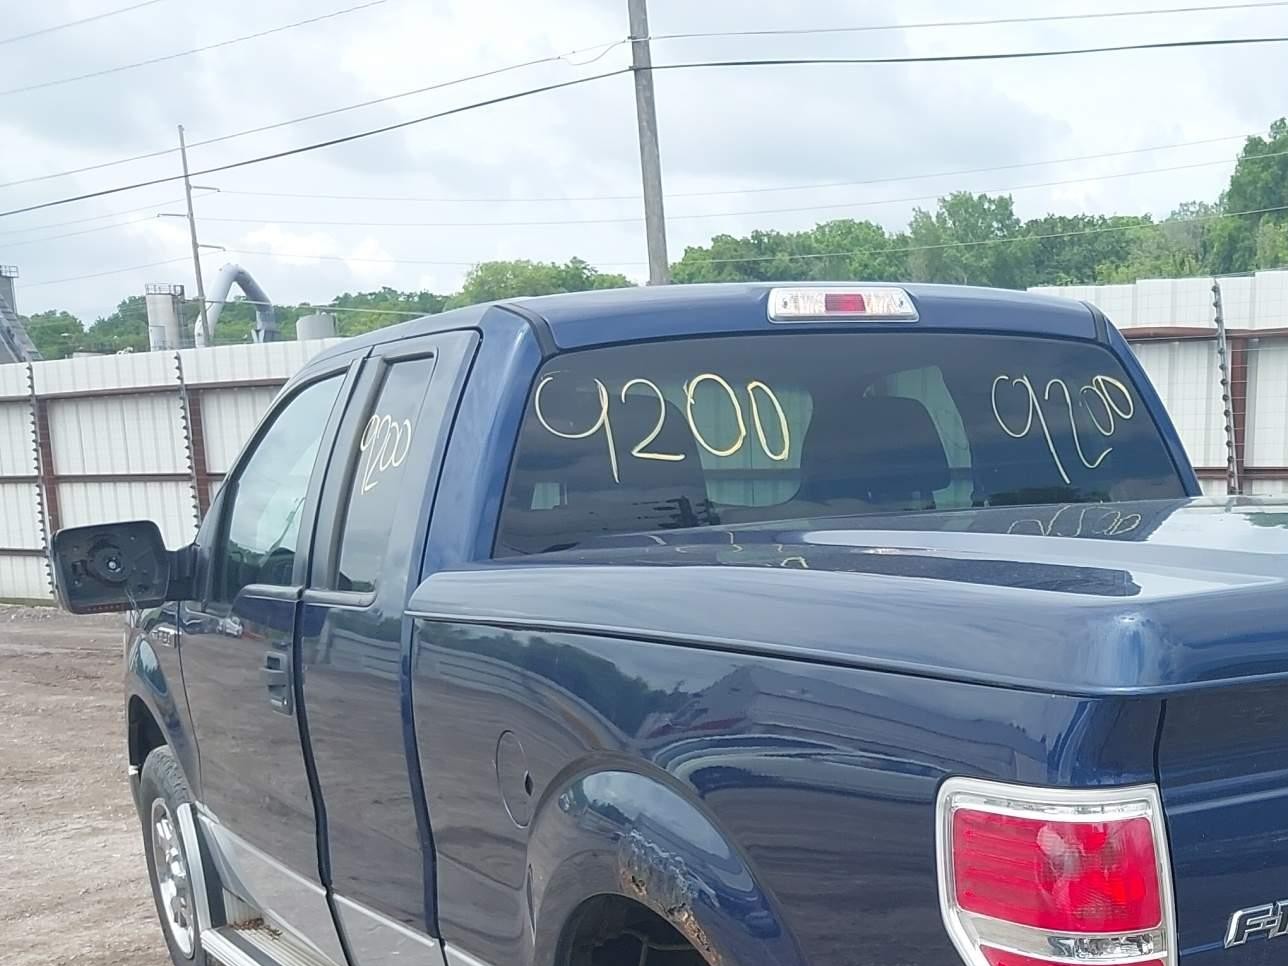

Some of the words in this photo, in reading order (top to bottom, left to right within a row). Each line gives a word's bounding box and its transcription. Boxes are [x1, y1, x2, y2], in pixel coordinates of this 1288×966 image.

[360, 414, 412, 496] 9200
[534, 370, 791, 484] 9200
[991, 374, 1135, 485] 9200
